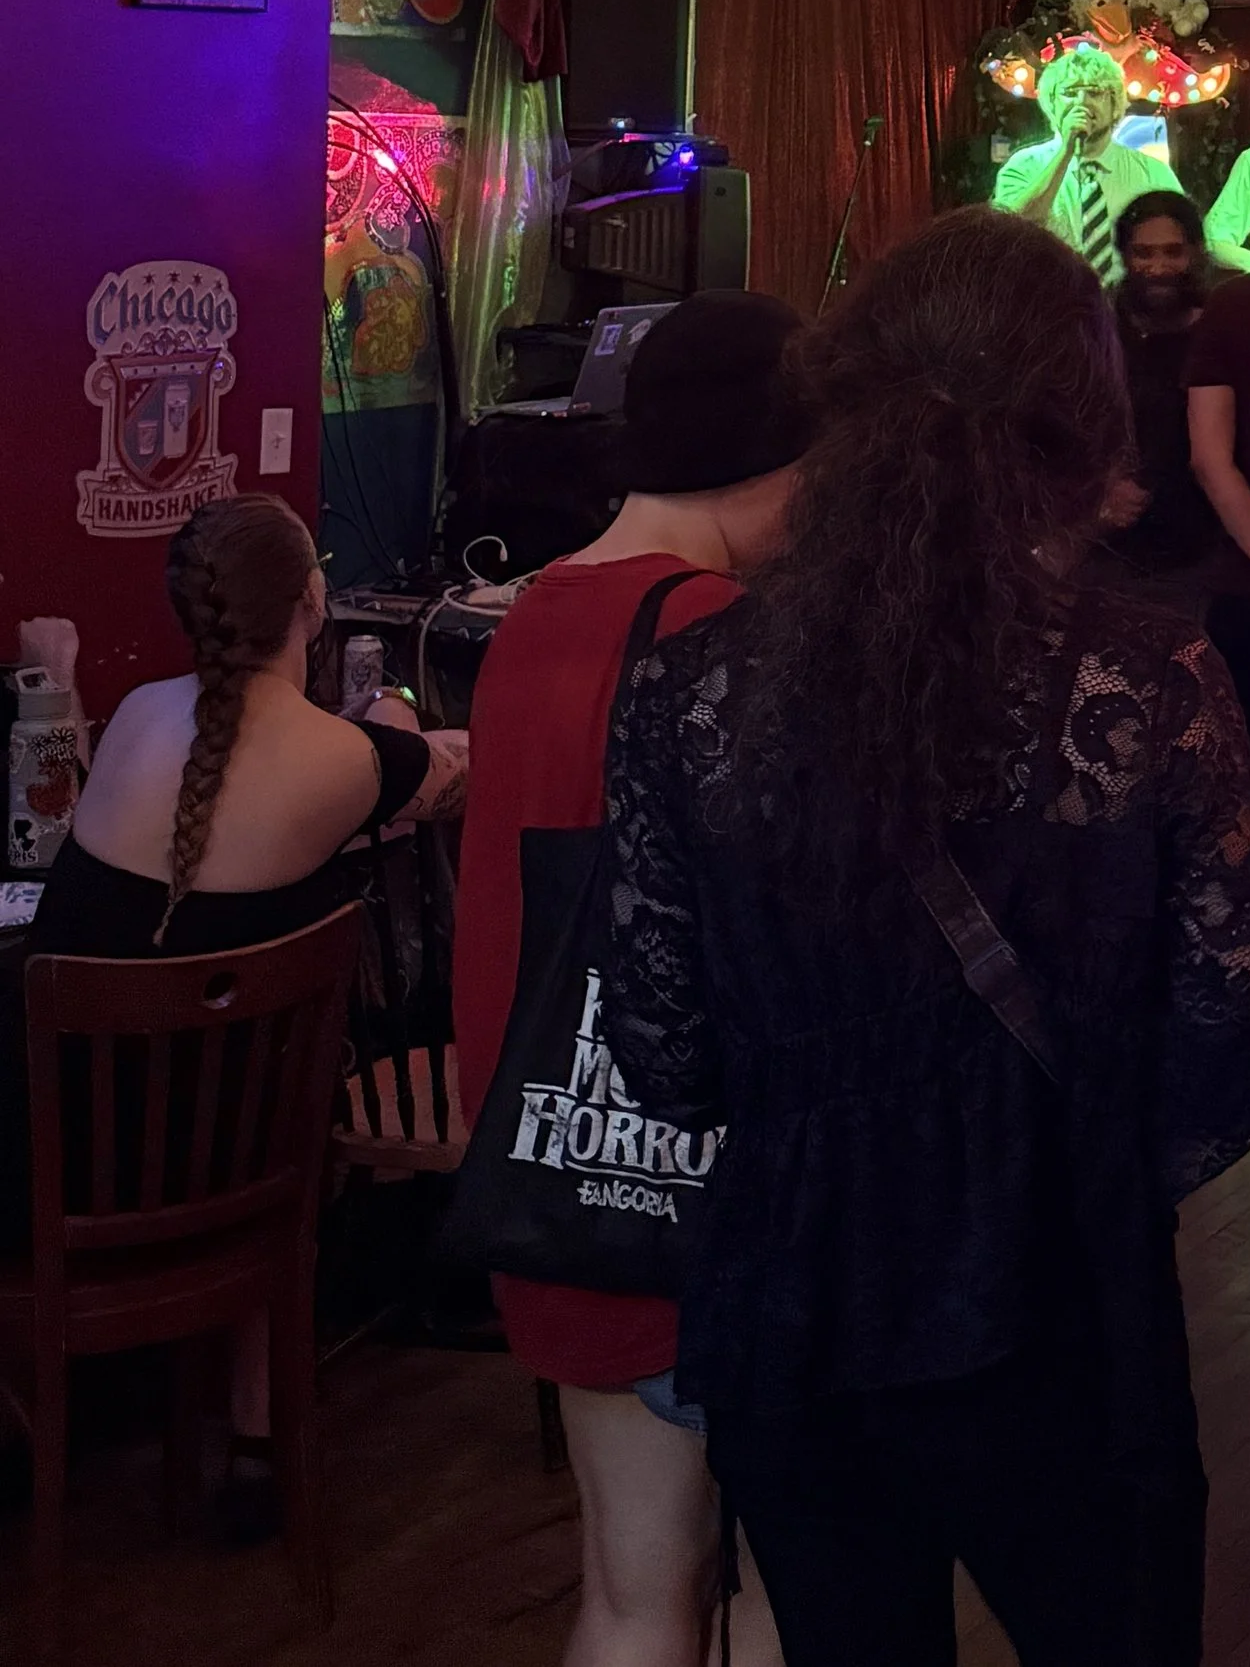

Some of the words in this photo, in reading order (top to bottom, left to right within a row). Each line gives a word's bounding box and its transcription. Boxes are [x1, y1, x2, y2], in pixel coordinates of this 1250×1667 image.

[94, 280, 233, 345] Chicago
[99, 484, 217, 521] HANDSHAKE
[508, 1091, 728, 1176] HORRO
[577, 1180, 678, 1223] FANGORIA
